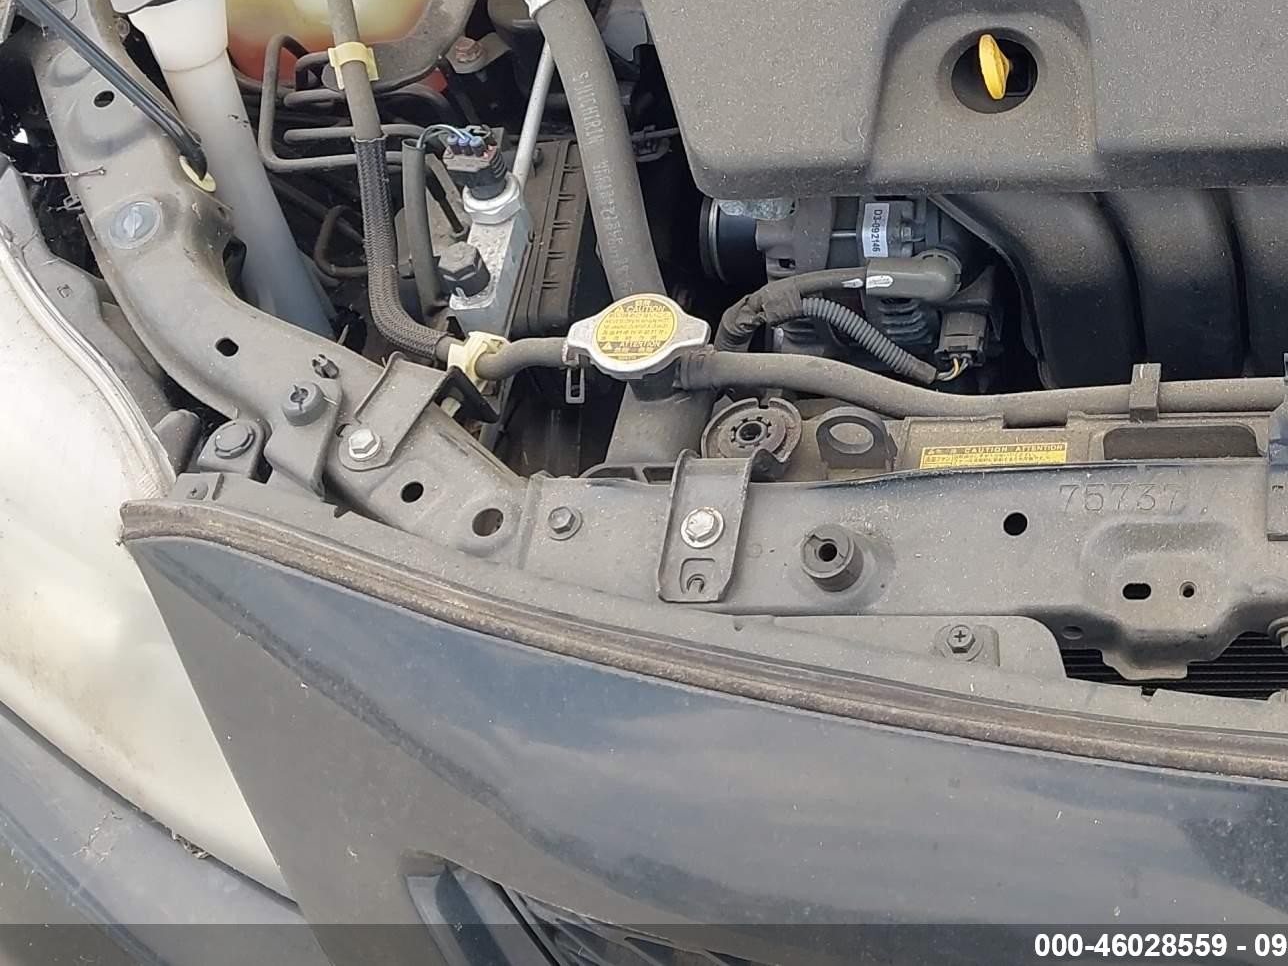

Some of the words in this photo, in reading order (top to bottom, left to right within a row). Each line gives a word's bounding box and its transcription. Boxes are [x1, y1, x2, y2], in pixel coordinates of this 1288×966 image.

[626, 305, 666, 313] CAUTION
[964, 446, 1008, 454] CAUTION
[1015, 444, 1064, 452] ATTENTION
